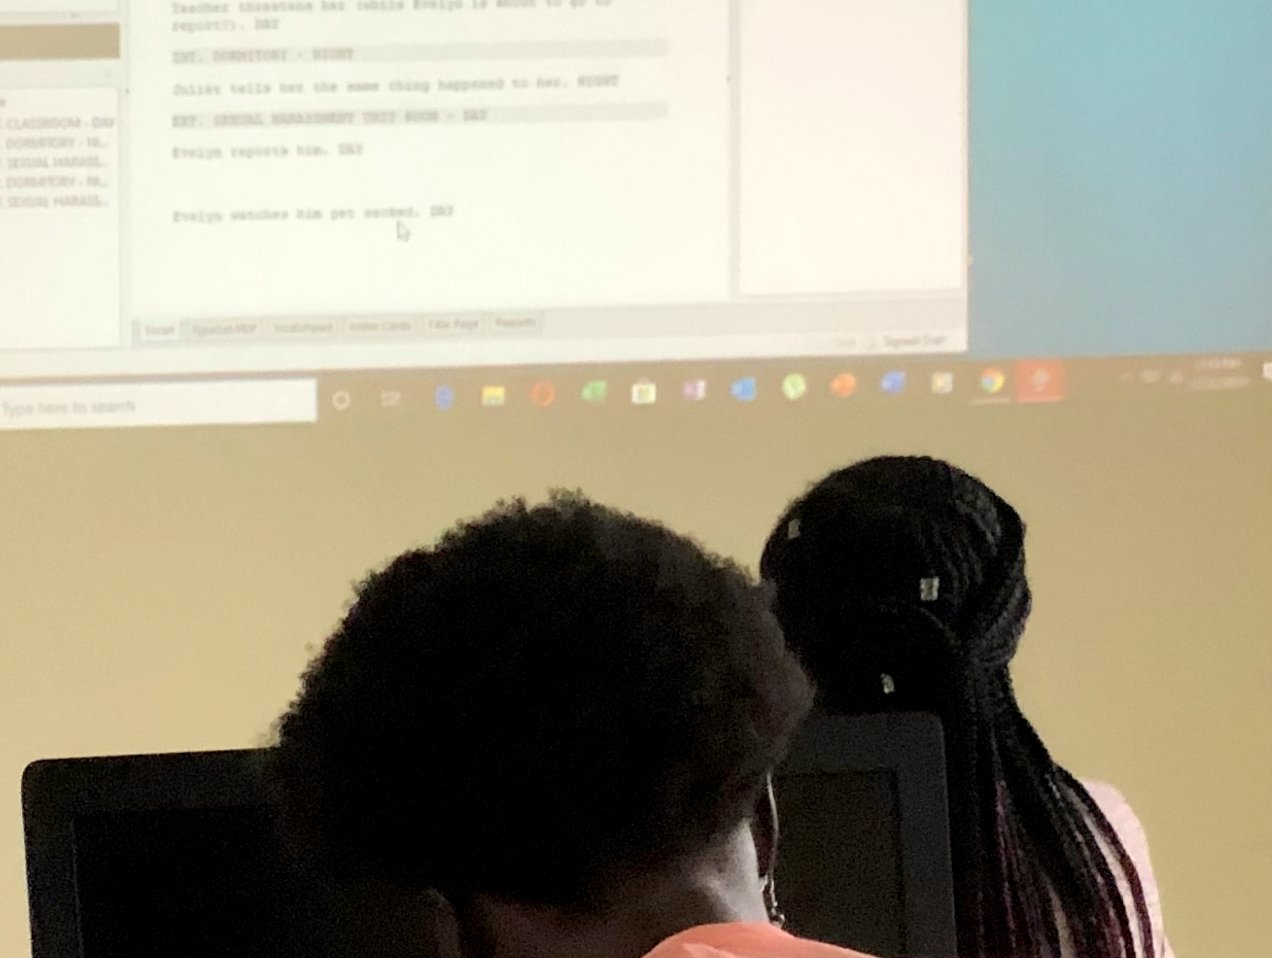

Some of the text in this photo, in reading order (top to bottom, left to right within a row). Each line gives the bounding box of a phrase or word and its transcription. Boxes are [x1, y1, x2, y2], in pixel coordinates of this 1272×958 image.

[279, 82, 303, 93] her
[314, 82, 337, 93] the
[296, 208, 322, 220] him
[2, 400, 136, 417] Type here to search
